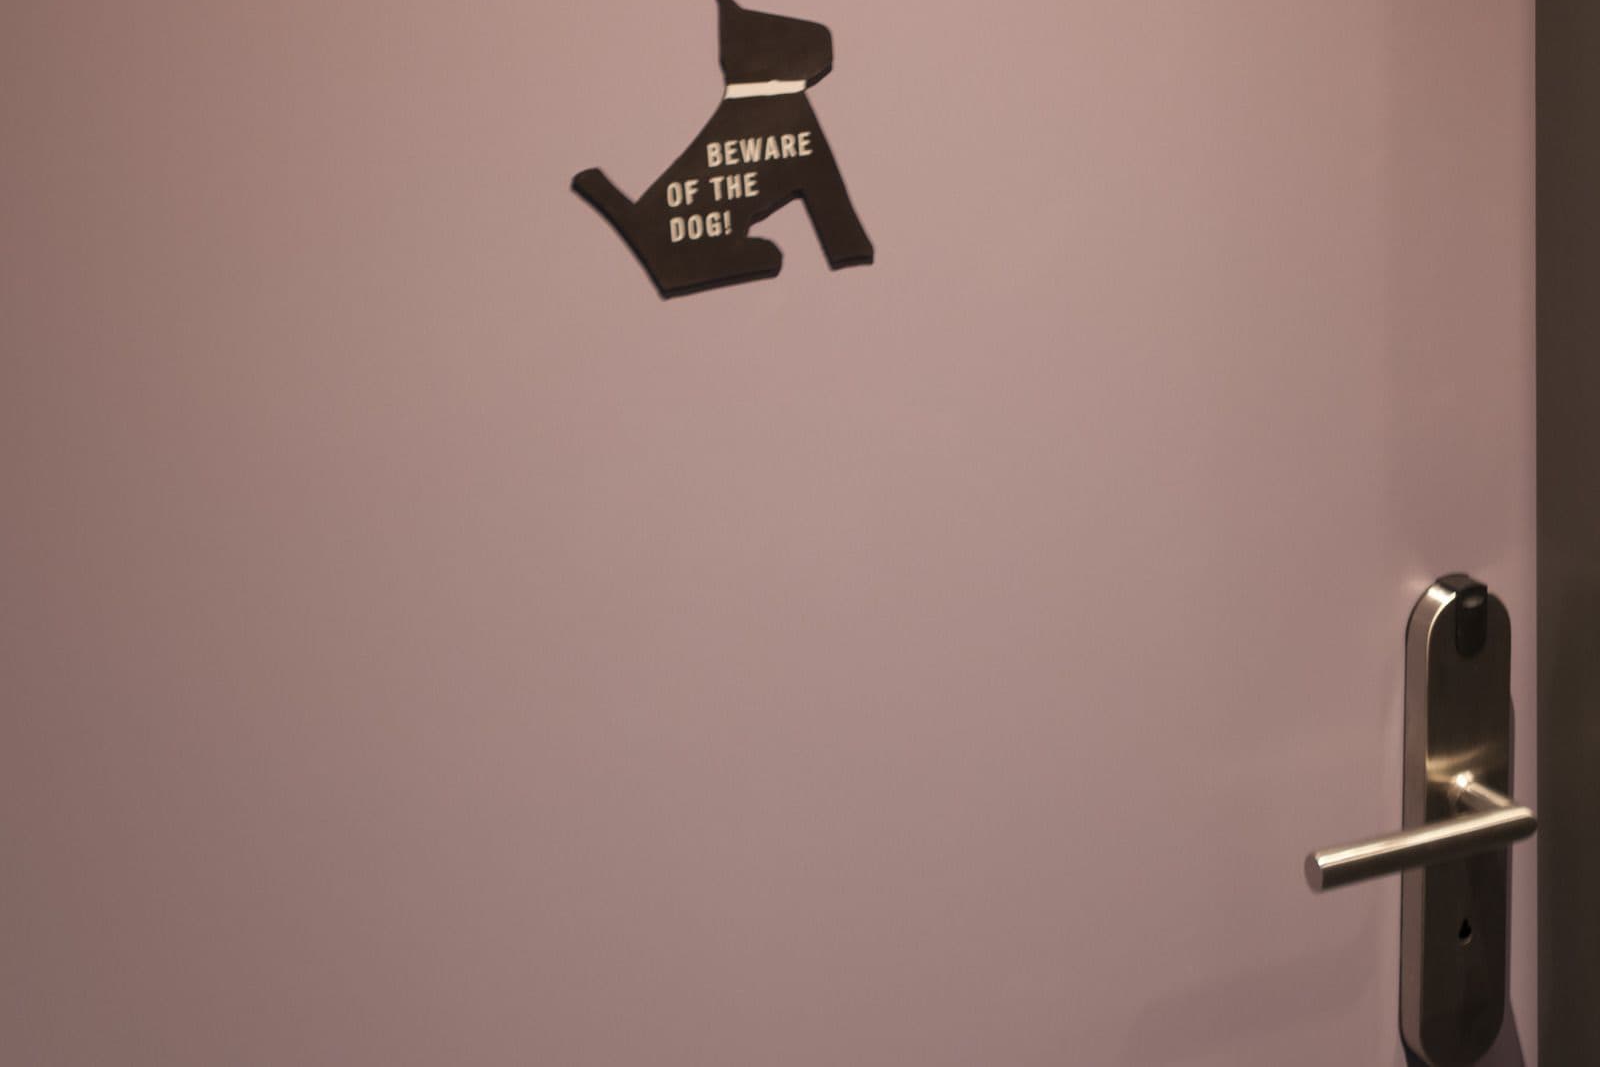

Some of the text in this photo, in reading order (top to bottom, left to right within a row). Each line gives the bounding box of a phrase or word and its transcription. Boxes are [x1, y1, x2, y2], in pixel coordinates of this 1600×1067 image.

[706, 131, 814, 168] BEWARE
[666, 171, 760, 208] OF THE
[669, 210, 733, 243] DOG!
